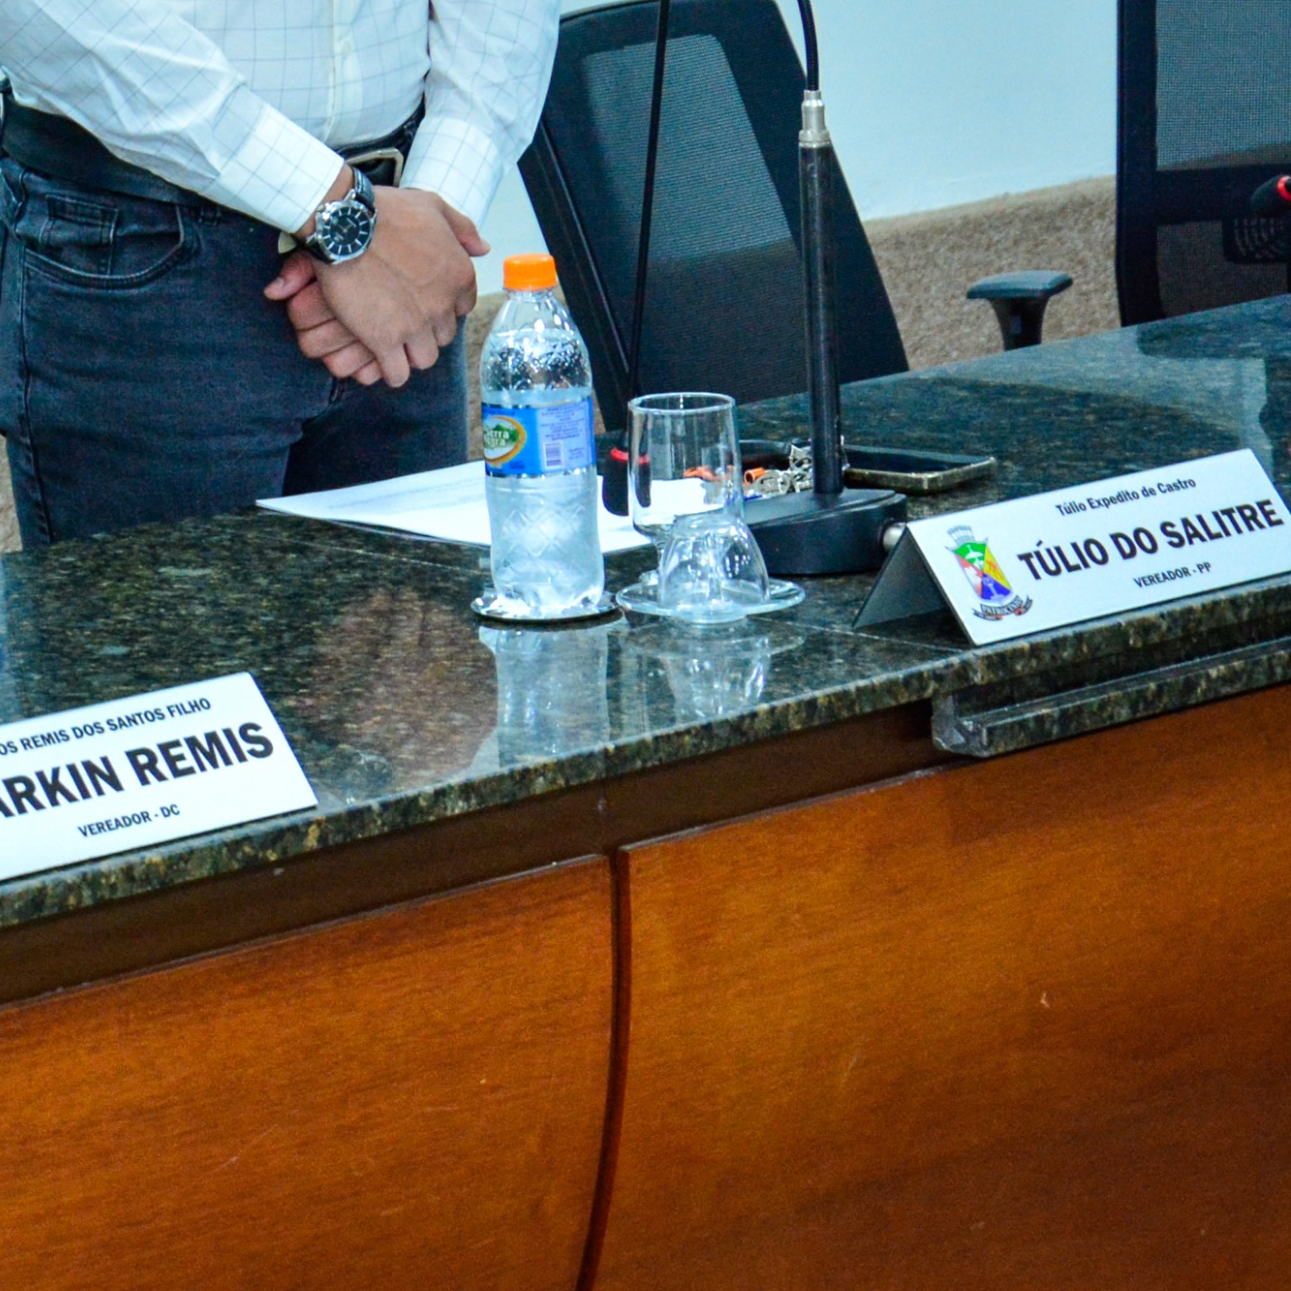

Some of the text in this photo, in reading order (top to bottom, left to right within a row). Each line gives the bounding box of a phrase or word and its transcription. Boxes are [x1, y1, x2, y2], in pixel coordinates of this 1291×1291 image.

[1087, 490, 1140, 509] Expedito
[1141, 486, 1157, 498] de
[1157, 478, 1197, 494] Castro
[1017, 498, 1285, 581] TÚLIO DO SALITRE
[1133, 566, 1192, 588] VEREADOR
[1196, 561, 1212, 574] PP
[19, 729, 71, 751] REMIS
[71, 719, 105, 739] DOS
[106, 707, 166, 732] SANTOS
[166, 697, 211, 718] FILHO
[124, 722, 275, 786] REMIS
[77, 810, 152, 838] VEREADOR
[159, 804, 180, 818] DC
